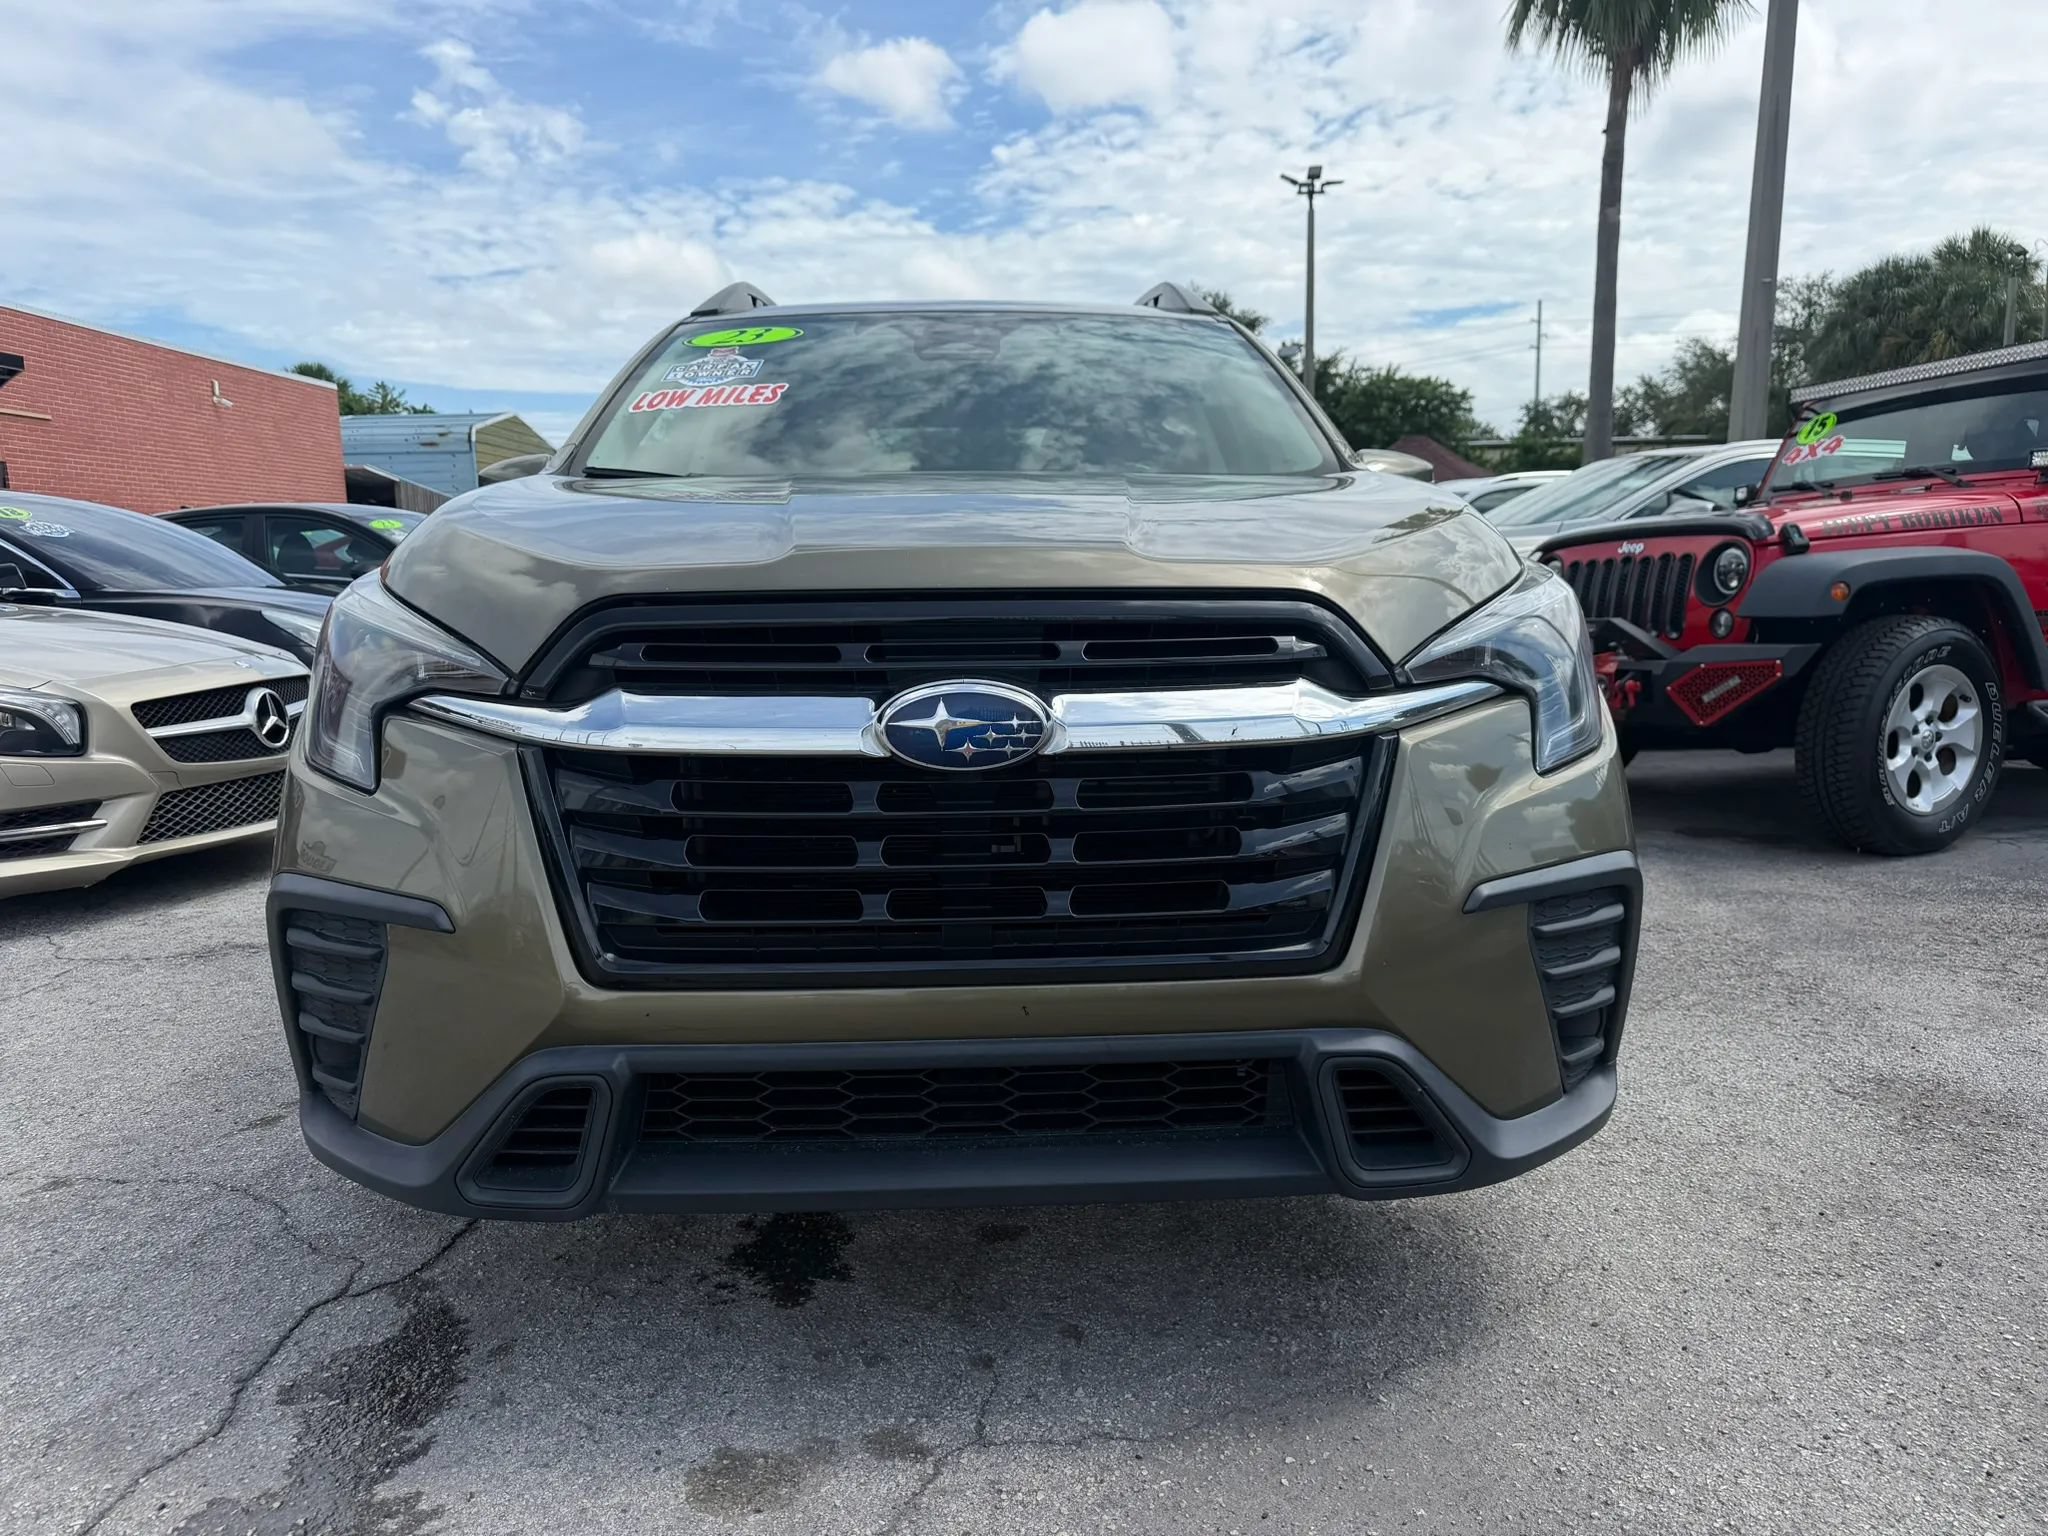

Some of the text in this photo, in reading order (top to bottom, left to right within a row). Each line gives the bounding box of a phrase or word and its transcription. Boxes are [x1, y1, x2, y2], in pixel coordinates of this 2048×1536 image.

[711, 328, 773, 344] 23
[632, 385, 786, 411] LOW MILES
[1804, 415, 1831, 439] 15
[1617, 541, 1645, 554] Jeep
[1938, 681, 2003, 834] DUELER A/T
